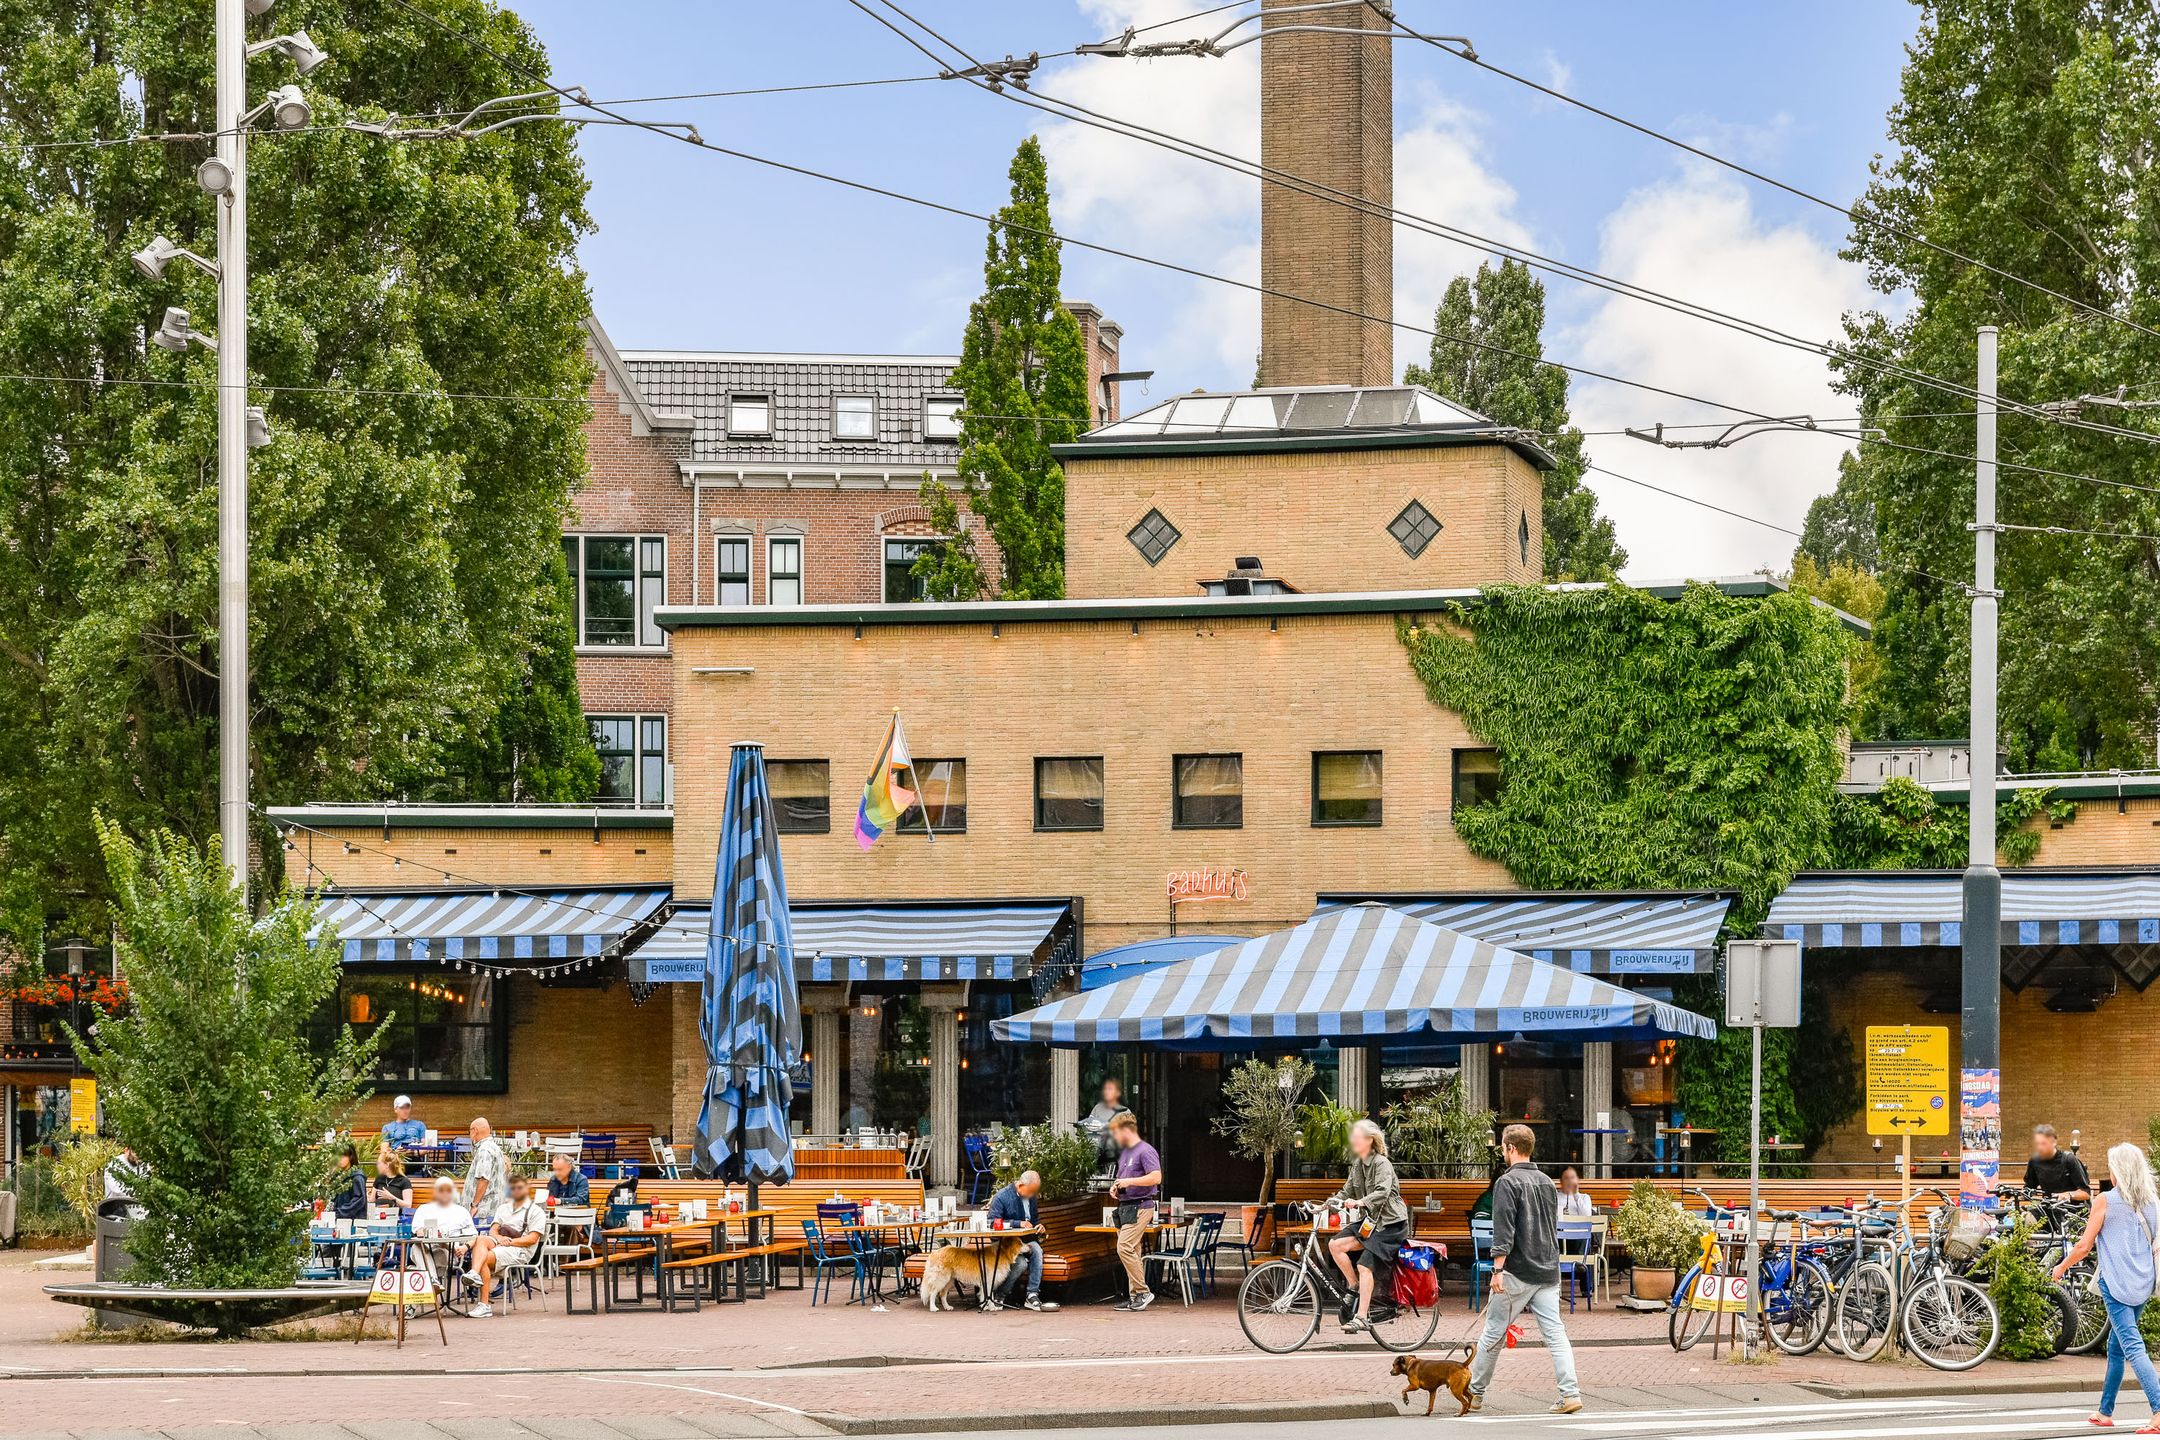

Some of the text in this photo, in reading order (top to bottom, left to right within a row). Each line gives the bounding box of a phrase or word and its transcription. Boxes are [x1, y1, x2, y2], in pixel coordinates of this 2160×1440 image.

[1615, 955, 1672, 966] BROUWERIJ
[1682, 955, 1689, 966] IJ
[651, 964, 704, 975] BROUWERIJ
[1523, 1008, 1589, 1023] BROUWERIJ
[1601, 1008, 1609, 1021] IJ
